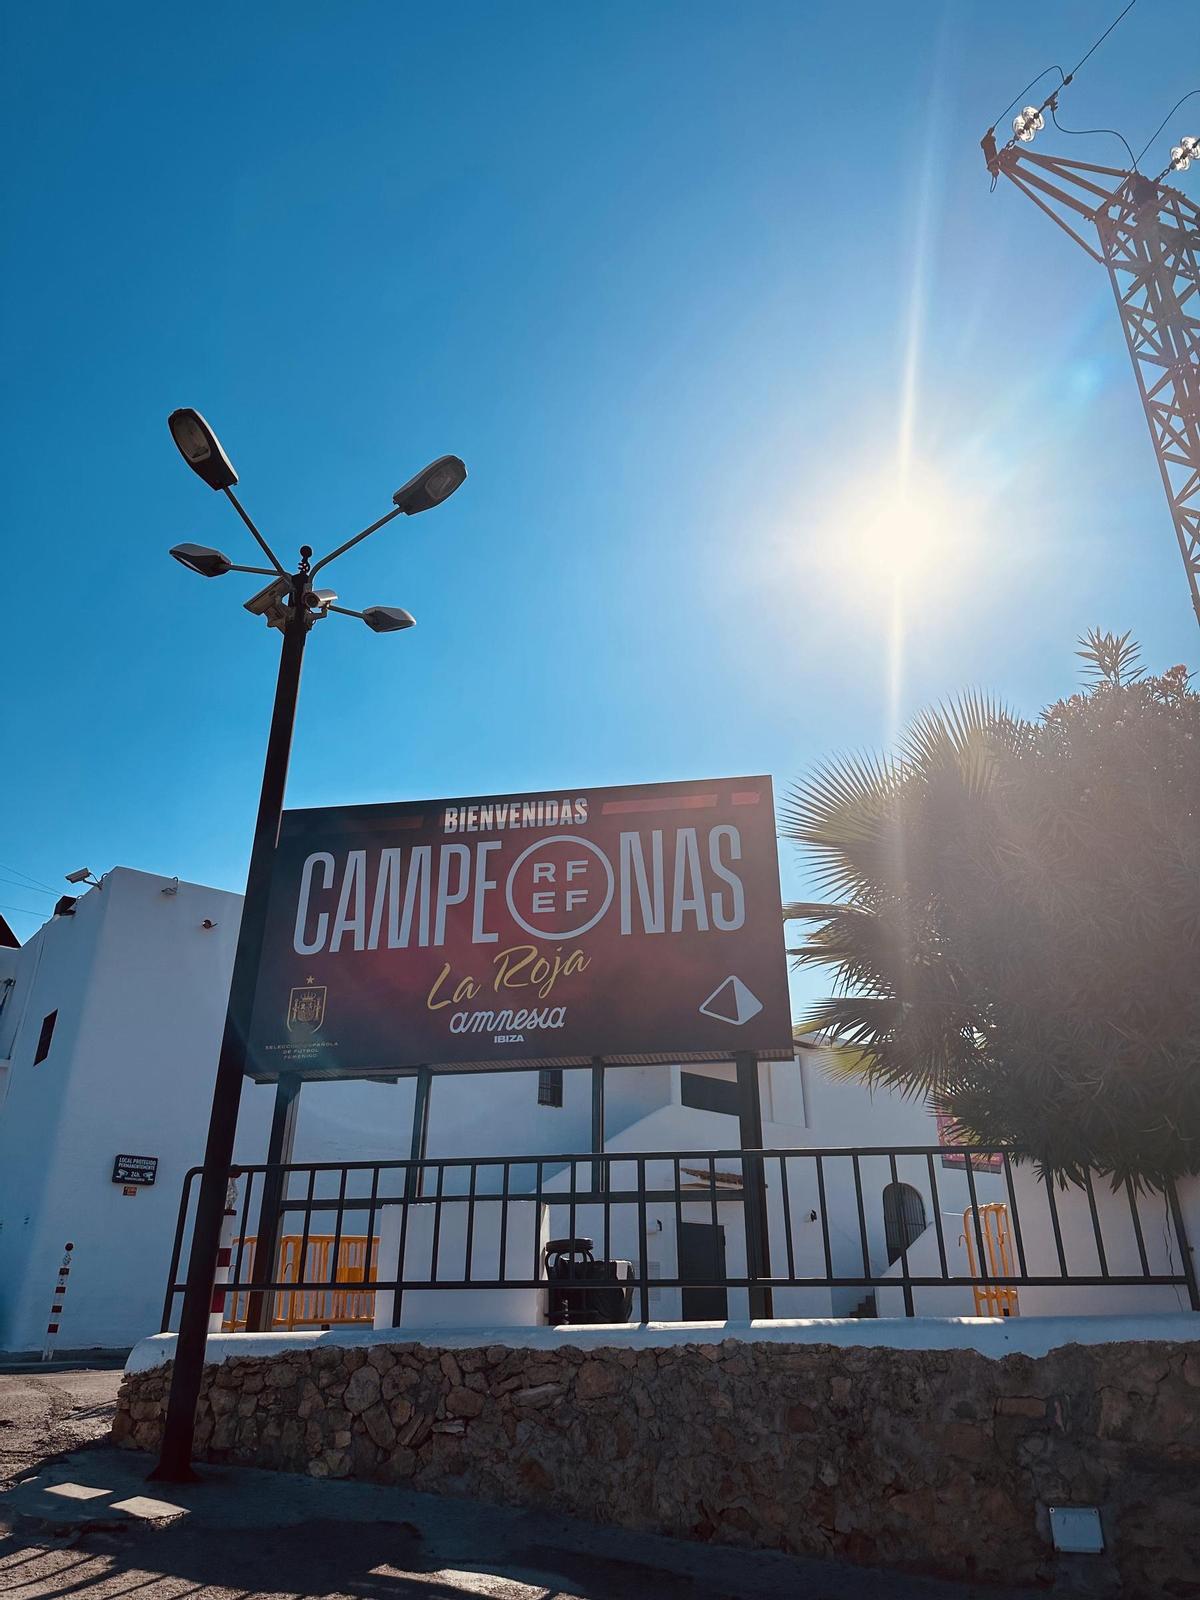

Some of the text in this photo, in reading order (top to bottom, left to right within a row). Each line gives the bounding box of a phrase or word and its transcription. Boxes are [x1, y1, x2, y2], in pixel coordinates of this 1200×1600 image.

[444, 798, 588, 833] BIENVENIDAS
[427, 945, 592, 1010] La Roja
[449, 1006, 567, 1034] amnesia
[494, 1034, 525, 1044] IBIZA
